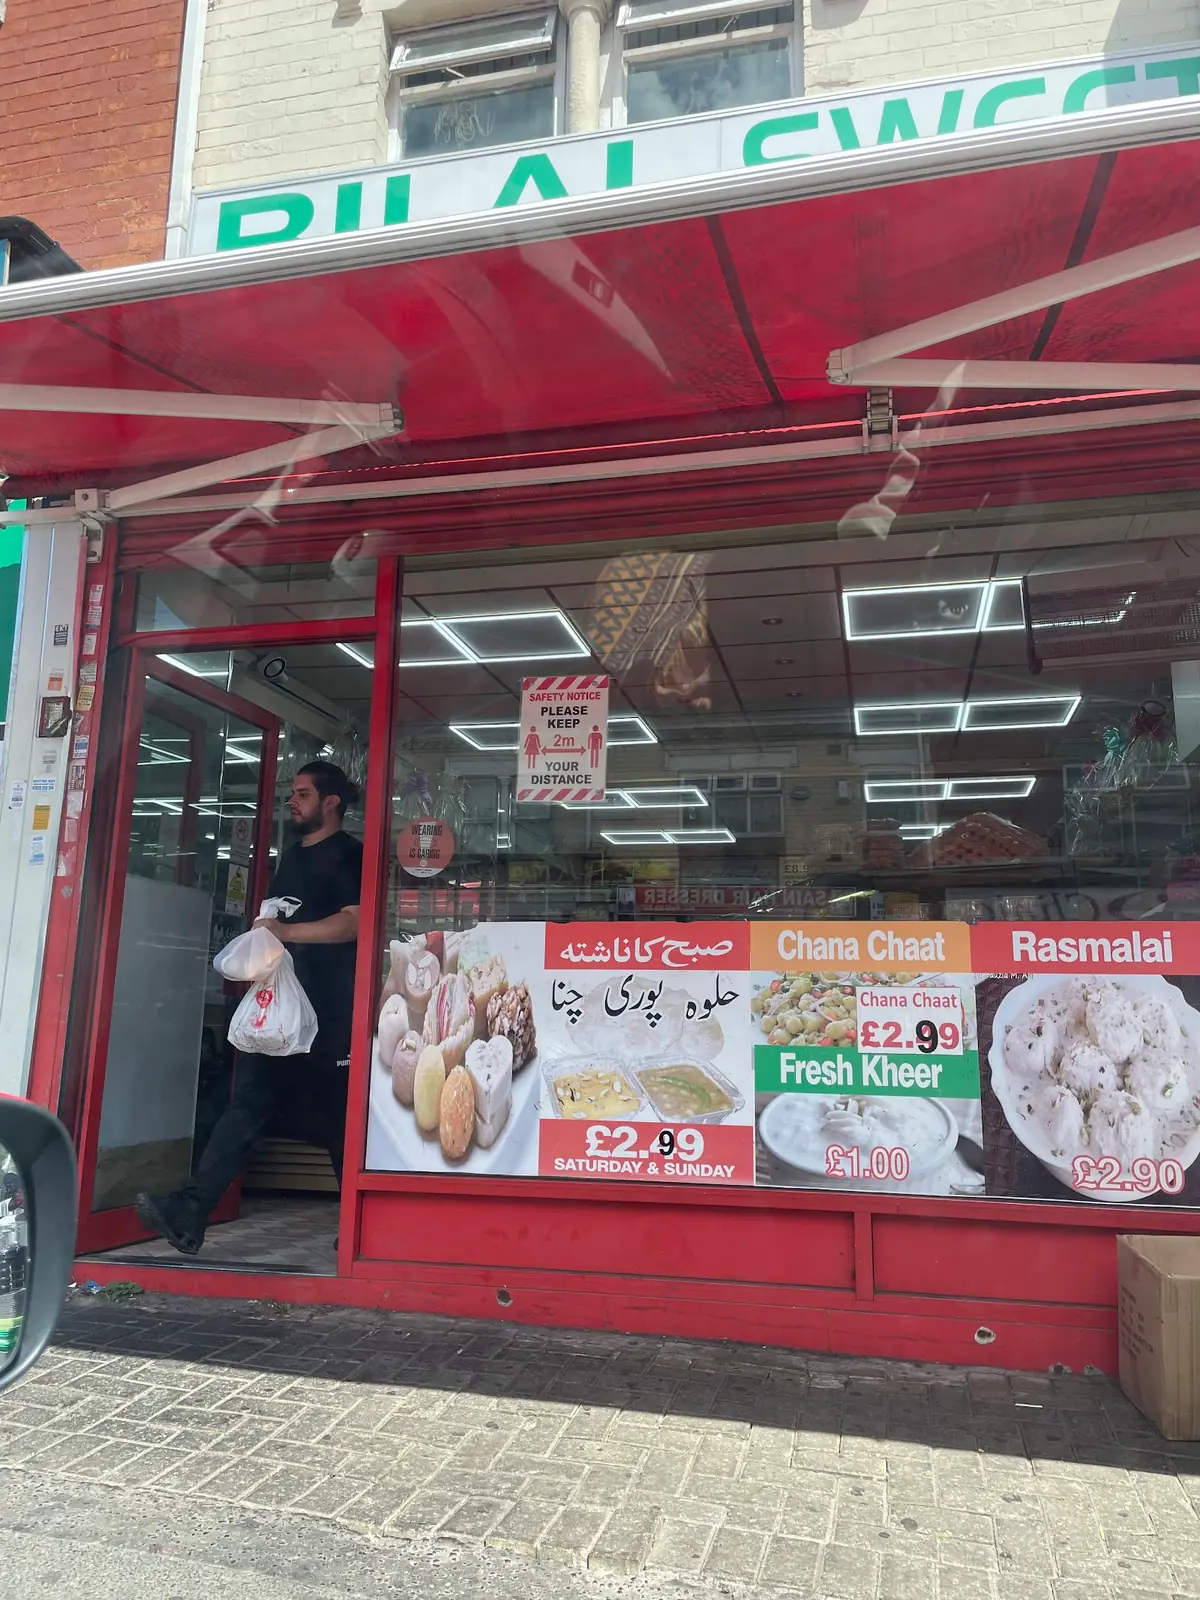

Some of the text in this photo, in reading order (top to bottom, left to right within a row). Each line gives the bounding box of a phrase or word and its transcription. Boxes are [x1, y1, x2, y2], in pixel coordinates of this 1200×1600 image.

[529, 691, 601, 702] SAFETY NOTICE
[540, 705, 588, 716] PLEASE
[547, 718, 580, 729] KEEP
[553, 734, 575, 747] 2m
[545, 761, 579, 772] YOUR
[531, 774, 592, 785] DISTANCE
[411, 824, 443, 836] WEARING
[409, 847, 416, 859] IS
[777, 929, 946, 962] Chana Chaat
[1012, 931, 1173, 963] Rasmalai
[661, 938, 733, 967] صبح
[860, 991, 958, 1009] Chana Chaat
[336, 1059, 351, 1067] PUM
[780, 1052, 943, 1089] Fresh Kheer
[554, 1157, 736, 1178] SATURDAY & SUNDAY
[825, 1144, 909, 1180] £1.00
[1071, 1155, 1185, 1195] £2.90
